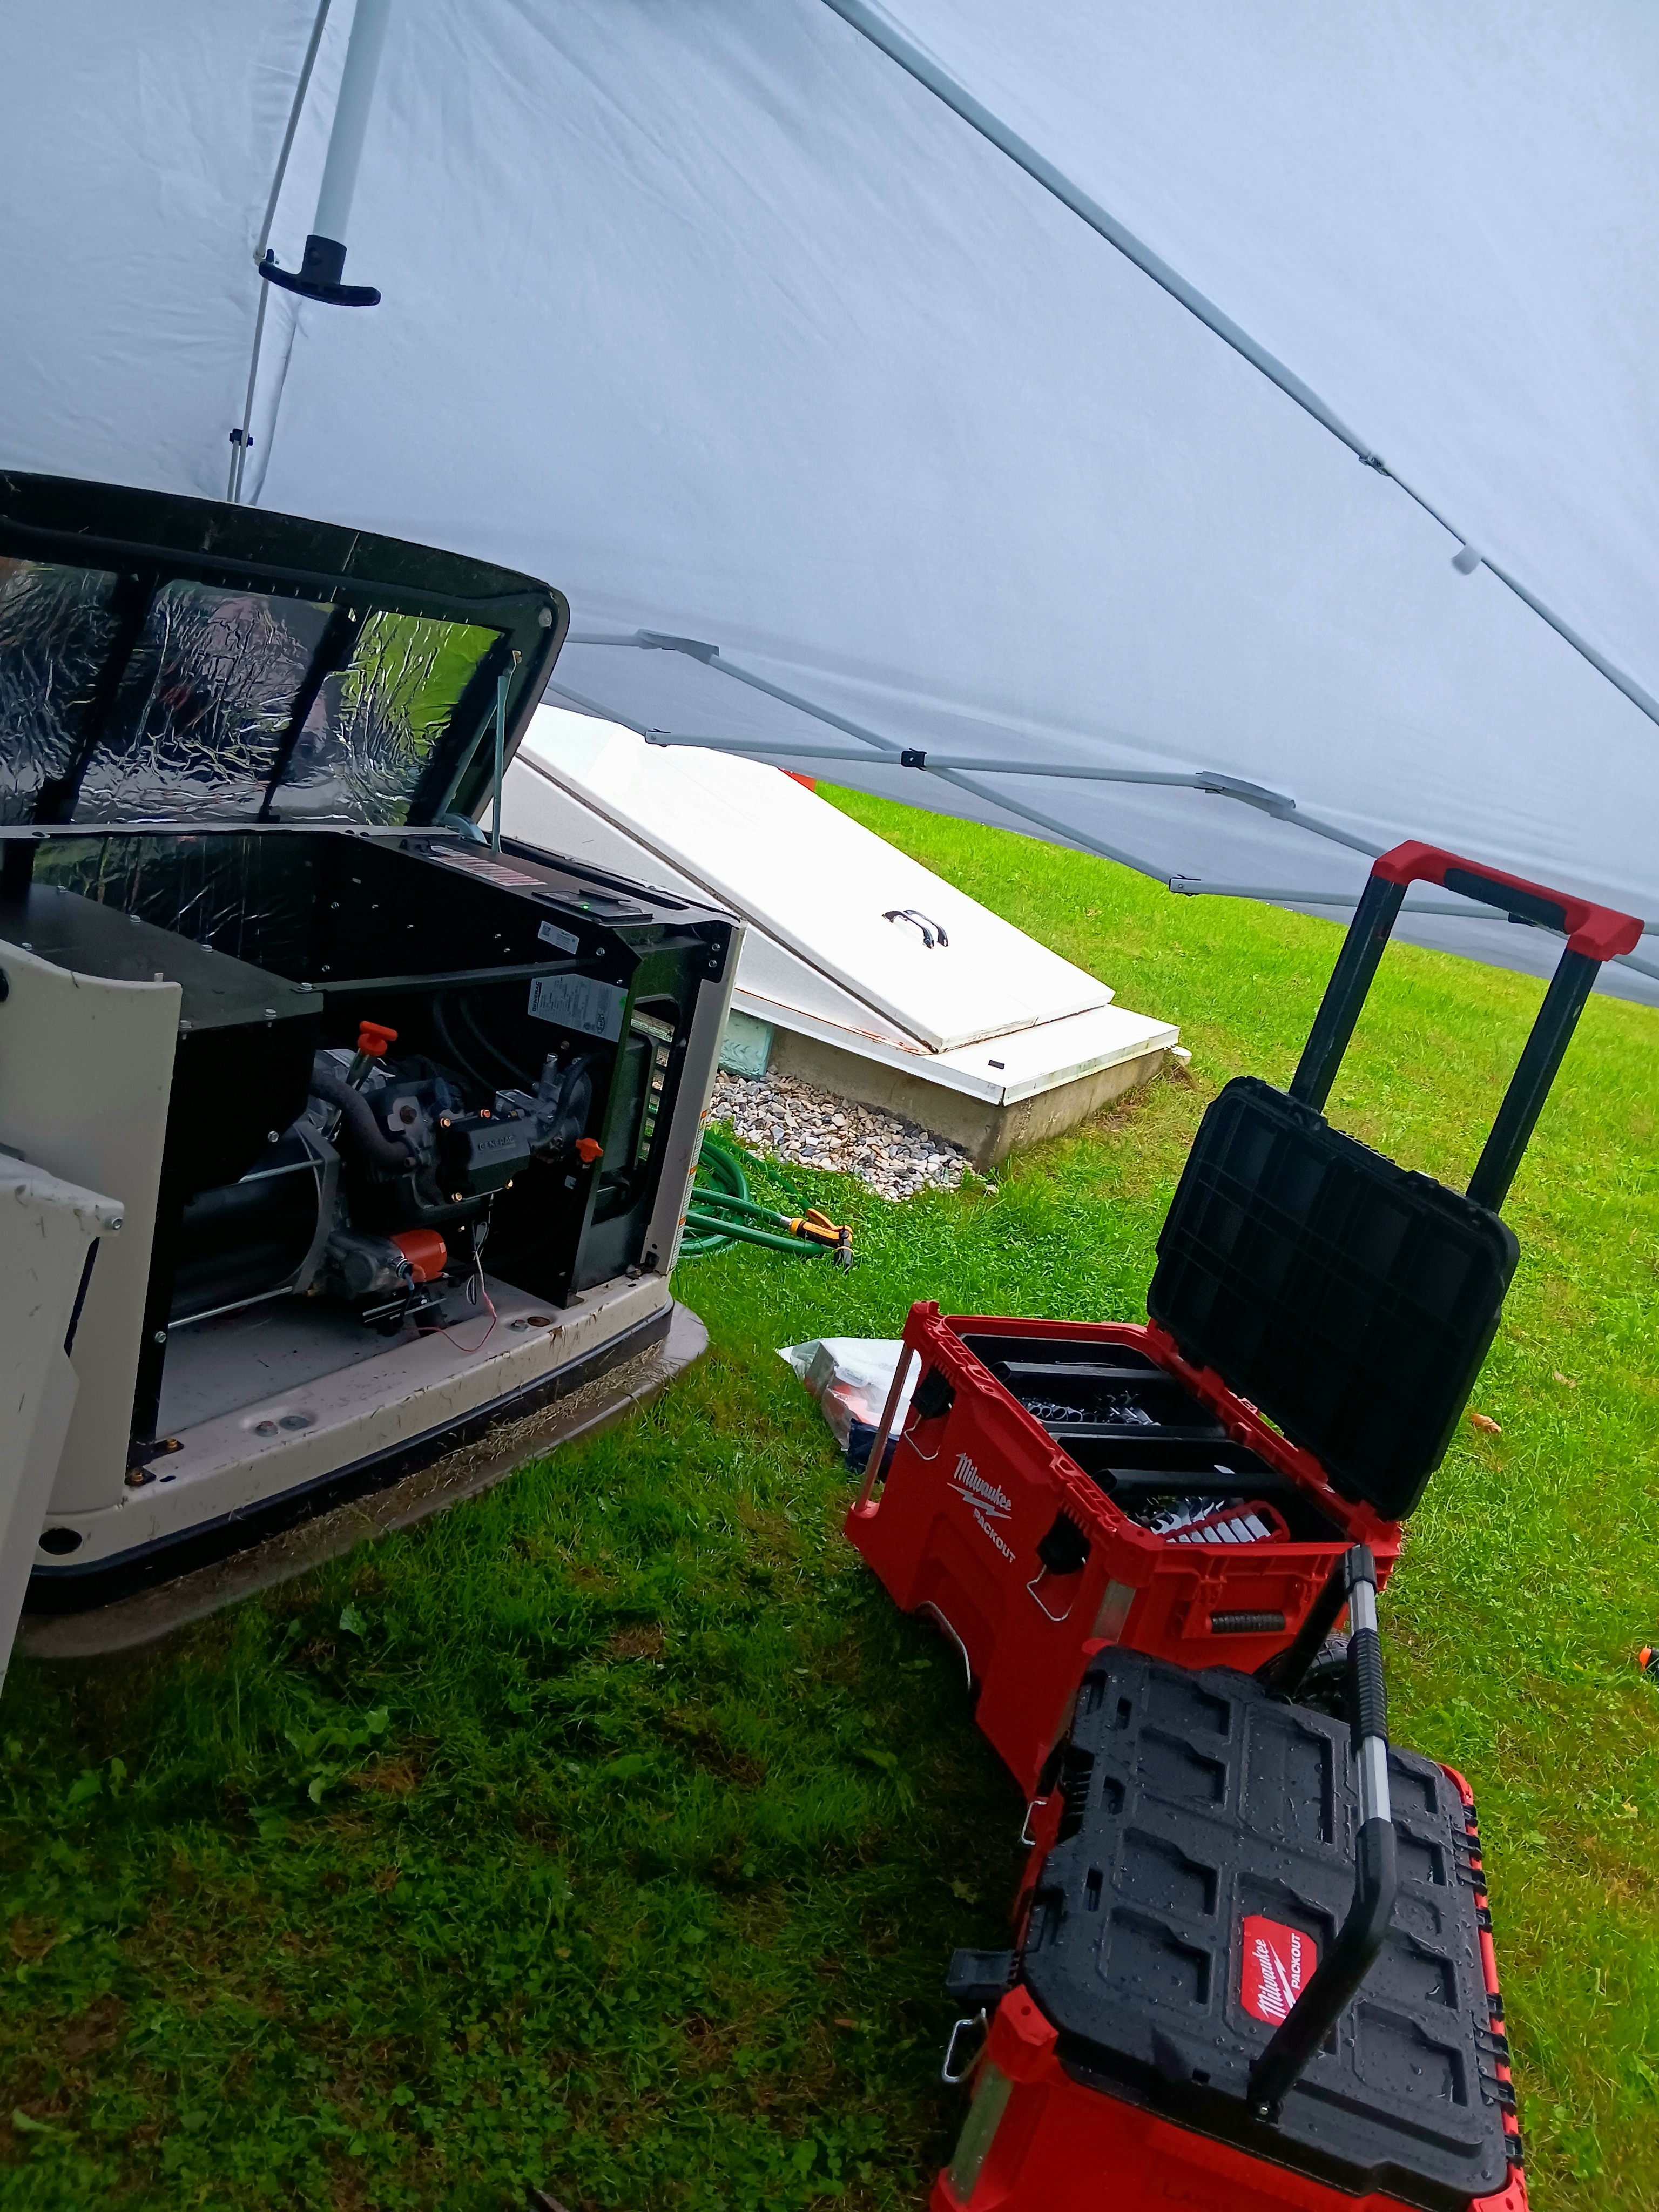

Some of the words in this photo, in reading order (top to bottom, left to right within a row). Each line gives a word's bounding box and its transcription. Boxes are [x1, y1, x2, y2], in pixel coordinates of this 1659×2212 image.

[532, 982, 541, 1012] GENERAC
[478, 1135, 515, 1150] GENERAC
[954, 1453, 1011, 1511] Milwaukee
[973, 1508, 1016, 1563] PACKOUT
[1252, 1938, 1287, 2019] Milwaukee
[1290, 1932, 1301, 1990] PACKOUT
